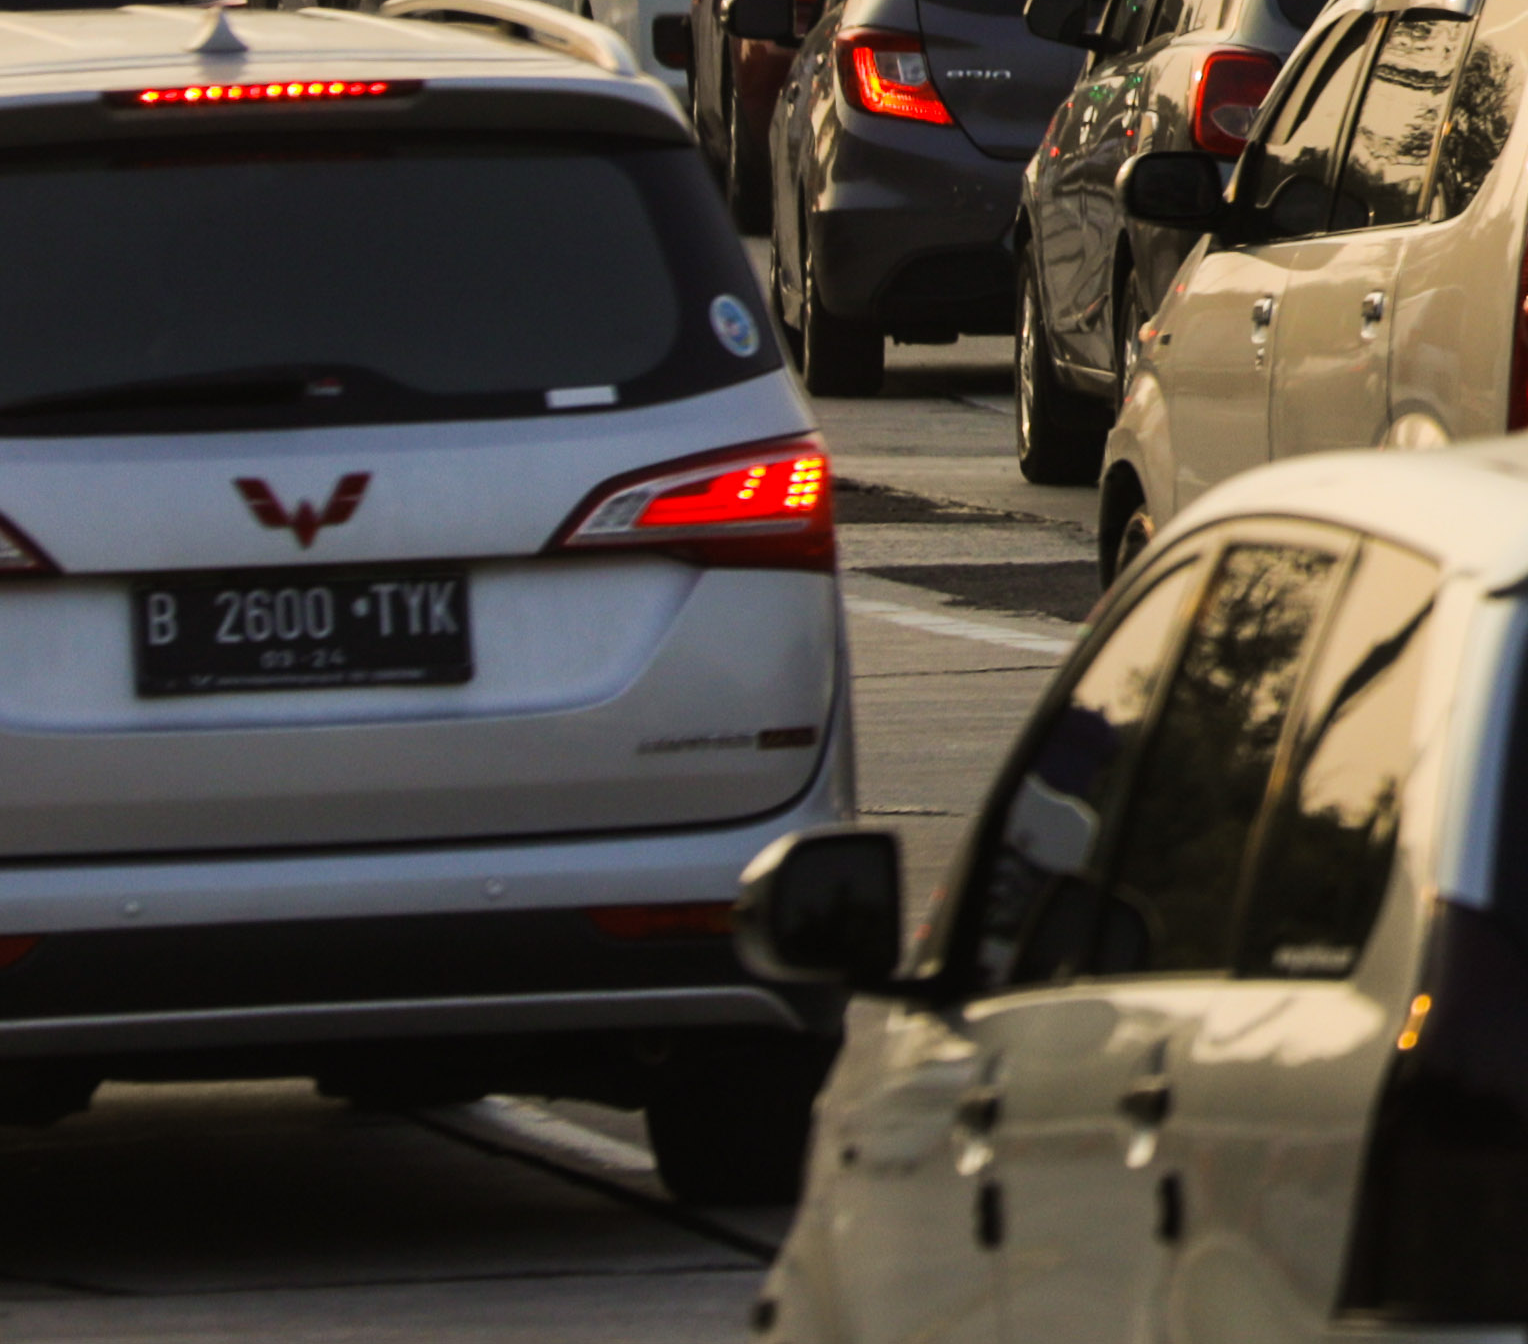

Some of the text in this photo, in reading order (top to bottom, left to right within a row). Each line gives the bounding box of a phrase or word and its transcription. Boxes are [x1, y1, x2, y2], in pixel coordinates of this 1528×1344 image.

[147, 581, 460, 645] B 2600 TYK
